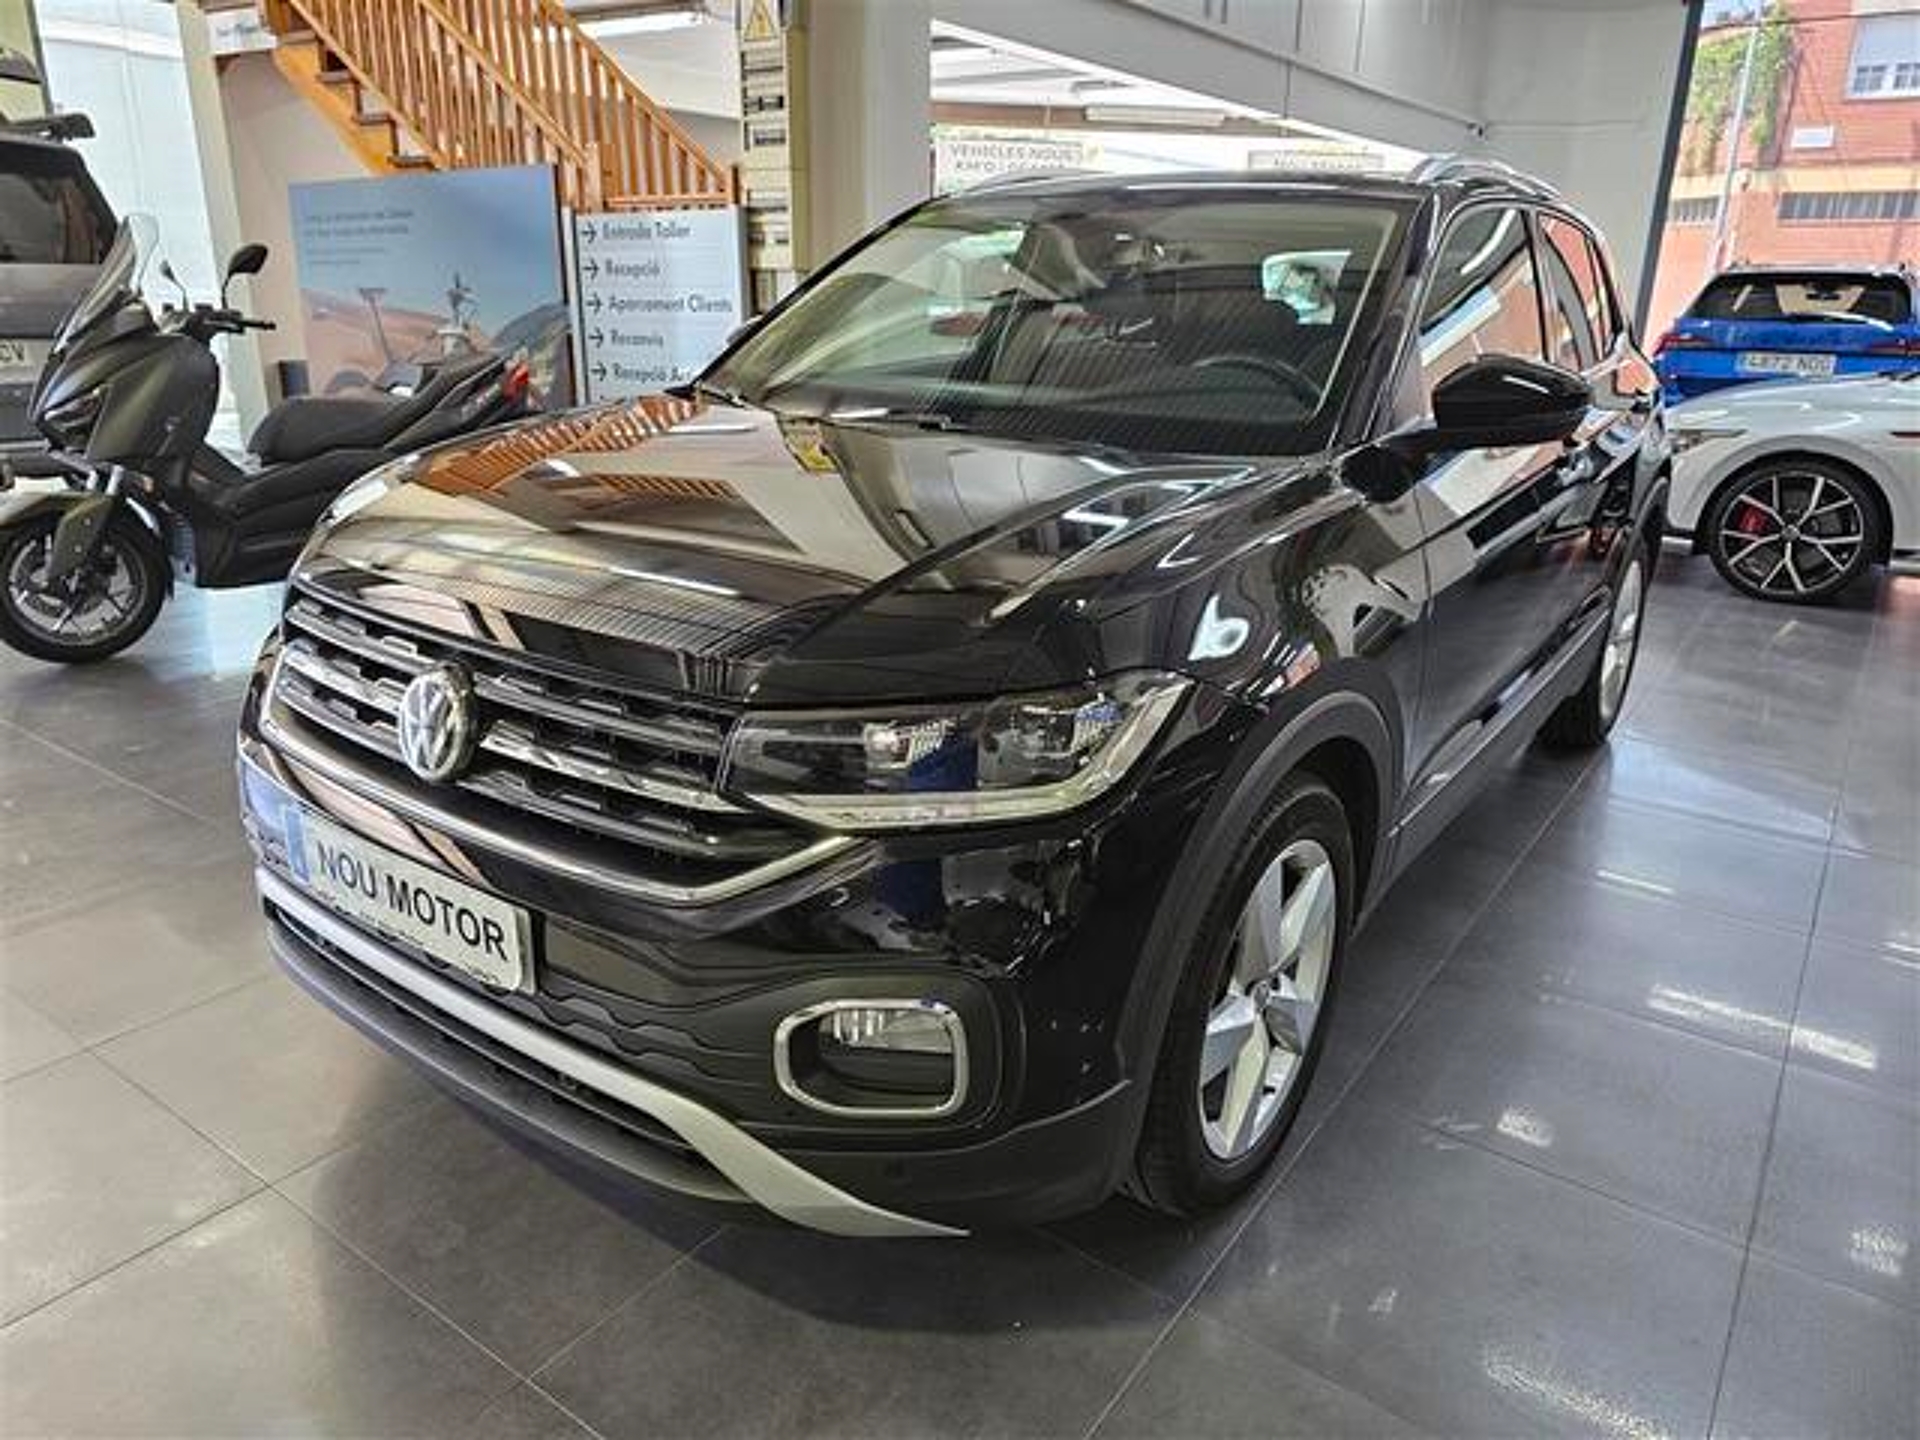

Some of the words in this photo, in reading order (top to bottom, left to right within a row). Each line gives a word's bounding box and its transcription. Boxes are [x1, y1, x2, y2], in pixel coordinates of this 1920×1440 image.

[655, 221, 690, 238] Taller
[605, 257, 660, 278] Recepció
[687, 293, 732, 313] Clients
[613, 362, 667, 384] Recepció
[317, 841, 378, 898] NOU
[385, 872, 509, 962] MOTOR
